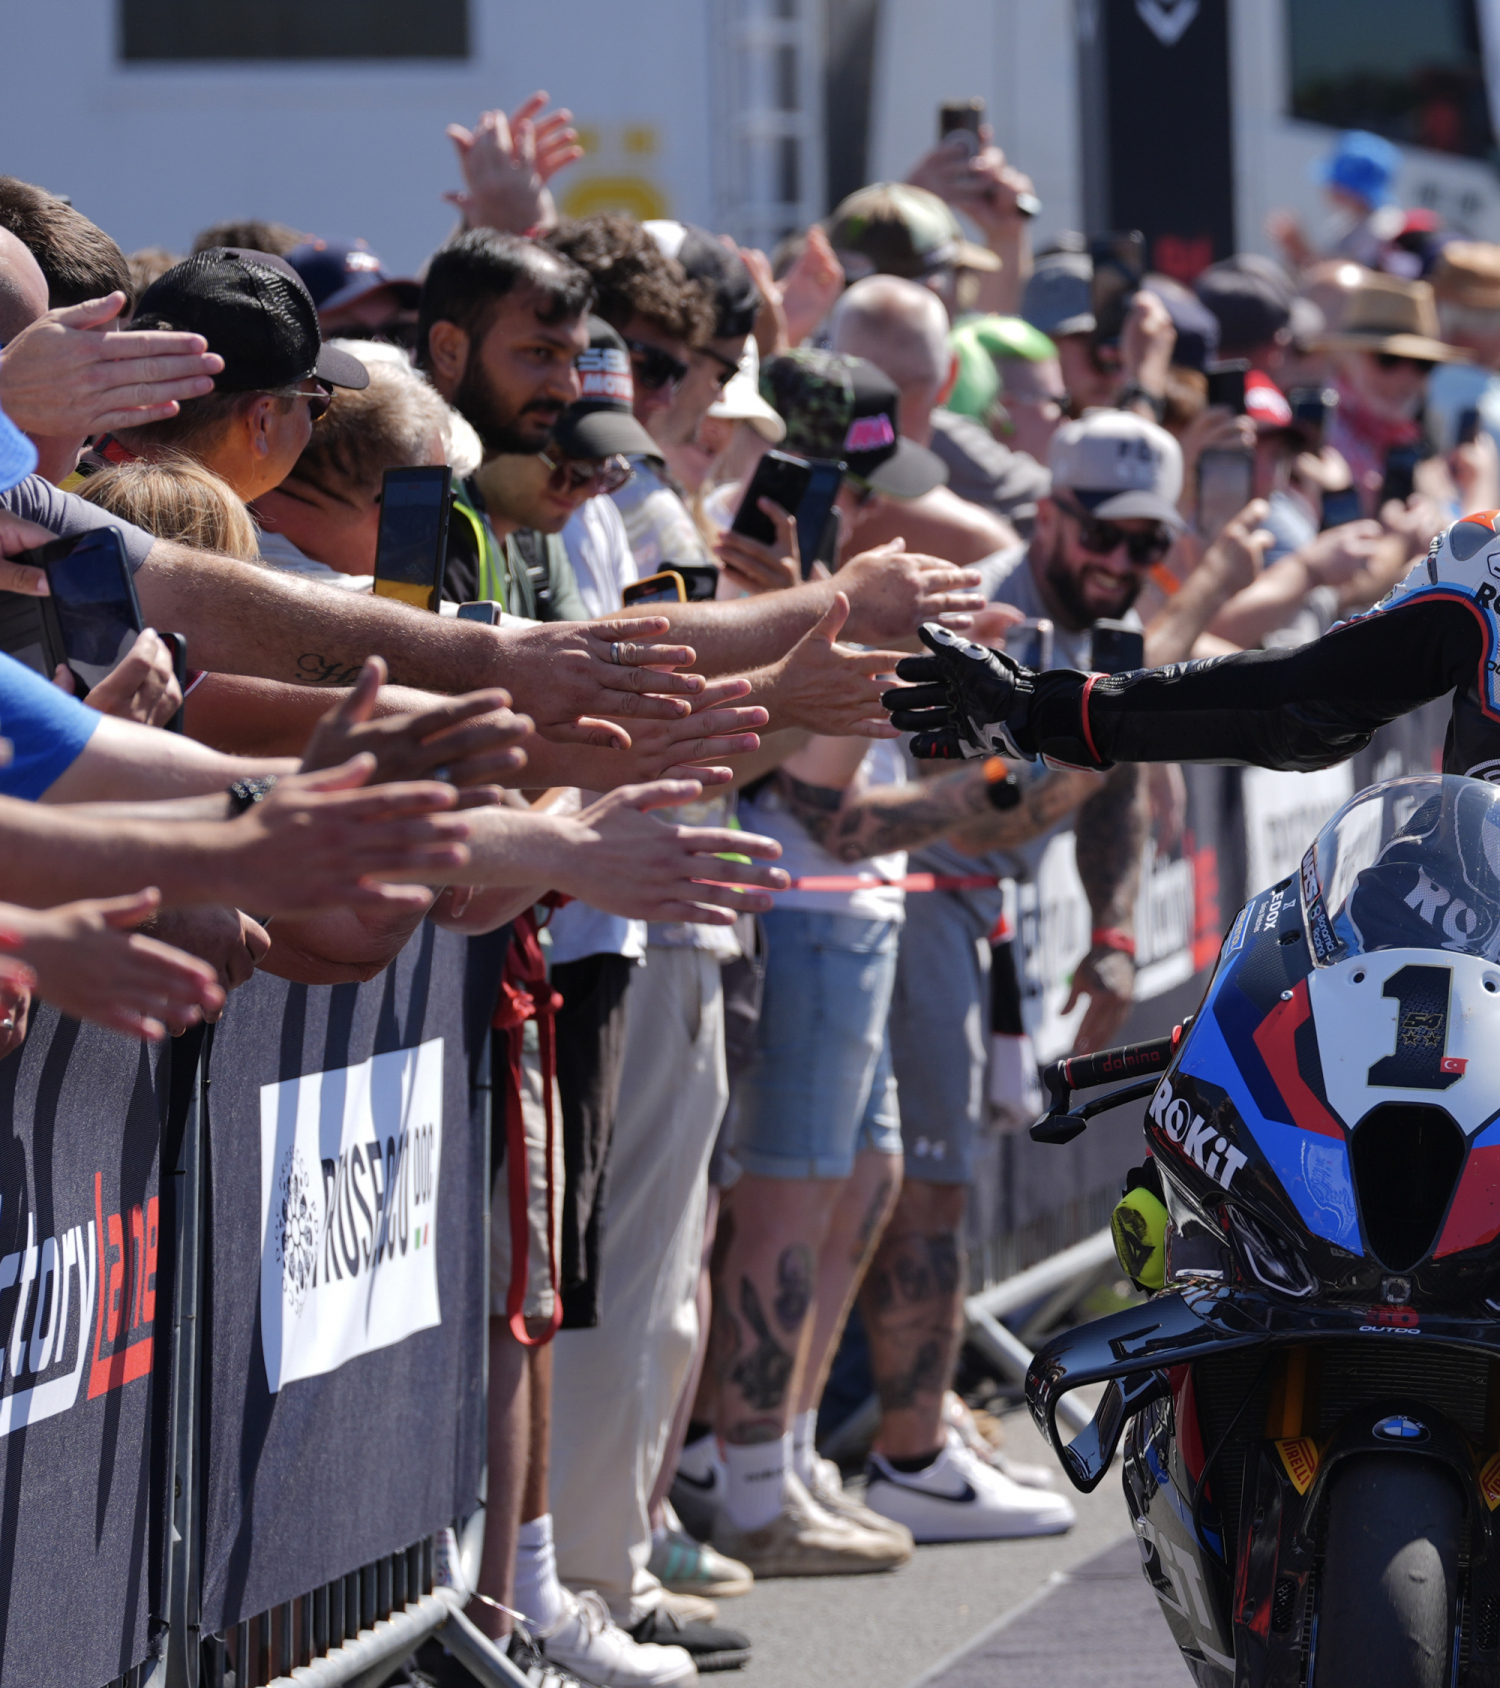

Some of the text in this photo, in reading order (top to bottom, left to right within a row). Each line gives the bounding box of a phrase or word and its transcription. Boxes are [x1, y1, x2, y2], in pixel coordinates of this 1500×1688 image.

[1263, 891, 1284, 932] EDOX
[1366, 963, 1466, 1092] 1
[1403, 1012, 1444, 1030] 54
[1103, 1048, 1160, 1072] domino
[1149, 1077, 1248, 1190] ROKiT
[414, 1122, 434, 1207] DOC
[1359, 1325, 1421, 1335] OUTDO
[1282, 1438, 1316, 1487] PIRELLI
